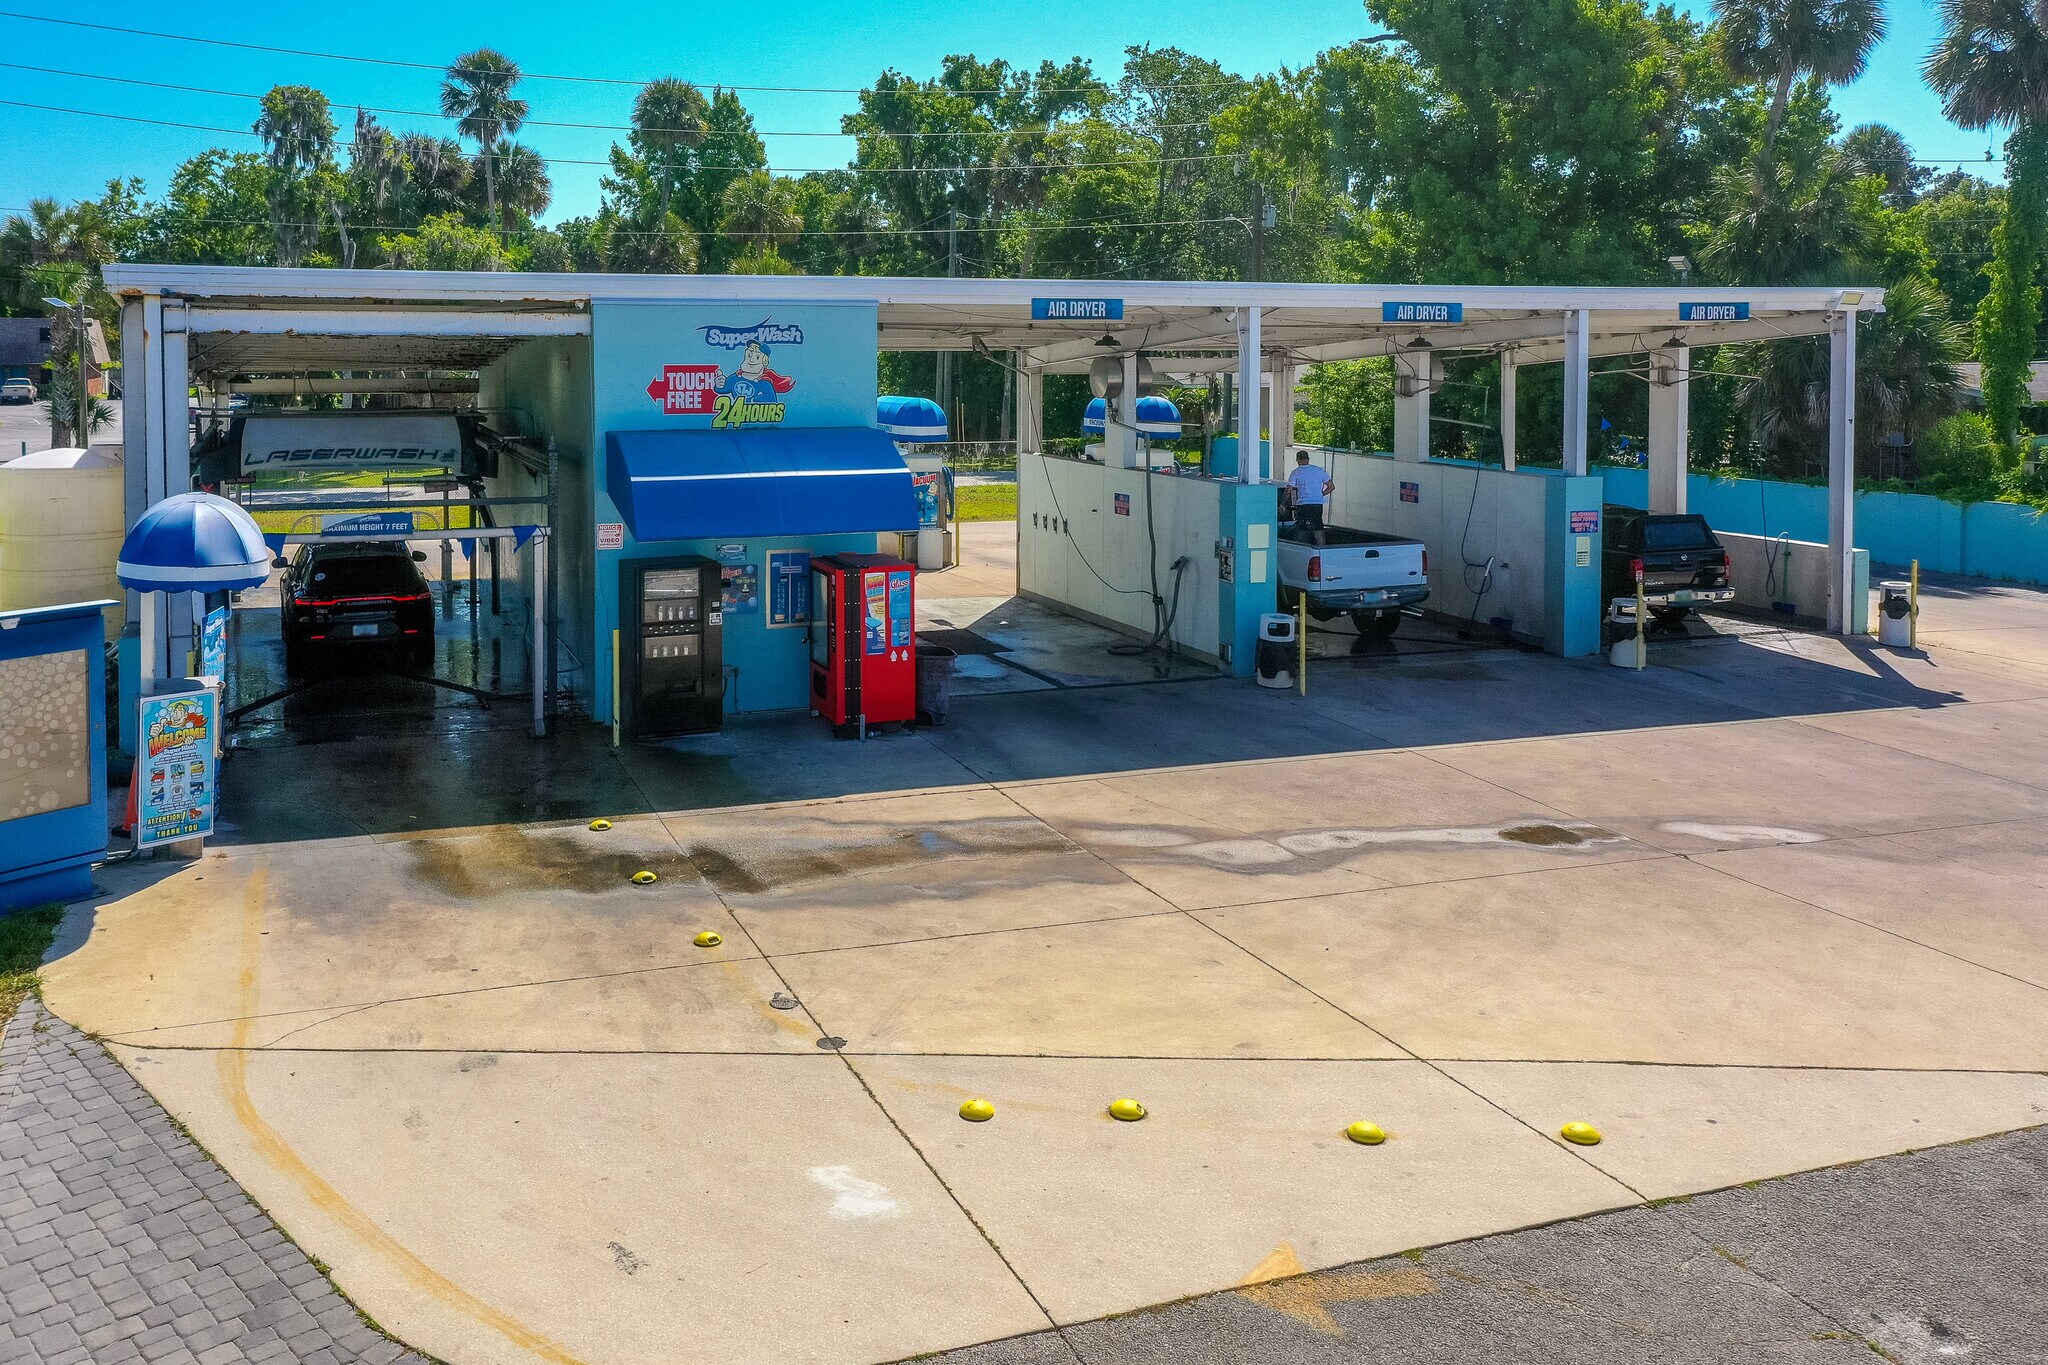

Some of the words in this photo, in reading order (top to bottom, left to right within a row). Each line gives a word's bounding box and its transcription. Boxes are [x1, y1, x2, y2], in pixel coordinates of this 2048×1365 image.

[1048, 301, 1067, 317] AIR
[1069, 301, 1106, 317] DRYER
[1397, 305, 1414, 320] AIR
[1416, 305, 1448, 320] DRYER
[1690, 305, 1706, 320] AIR
[1707, 305, 1736, 320] DRYER
[666, 372, 715, 390] TOUCH
[667, 391, 702, 409] FREE
[244, 448, 440, 466] LASERWASH
[324, 524, 358, 532] AXIMUM
[360, 523, 384, 531] HEIGHT
[891, 578, 909, 588] Glass
[148, 727, 207, 758] WELCOME
[157, 827, 181, 838] THANK
[184, 824, 198, 833] YOU
